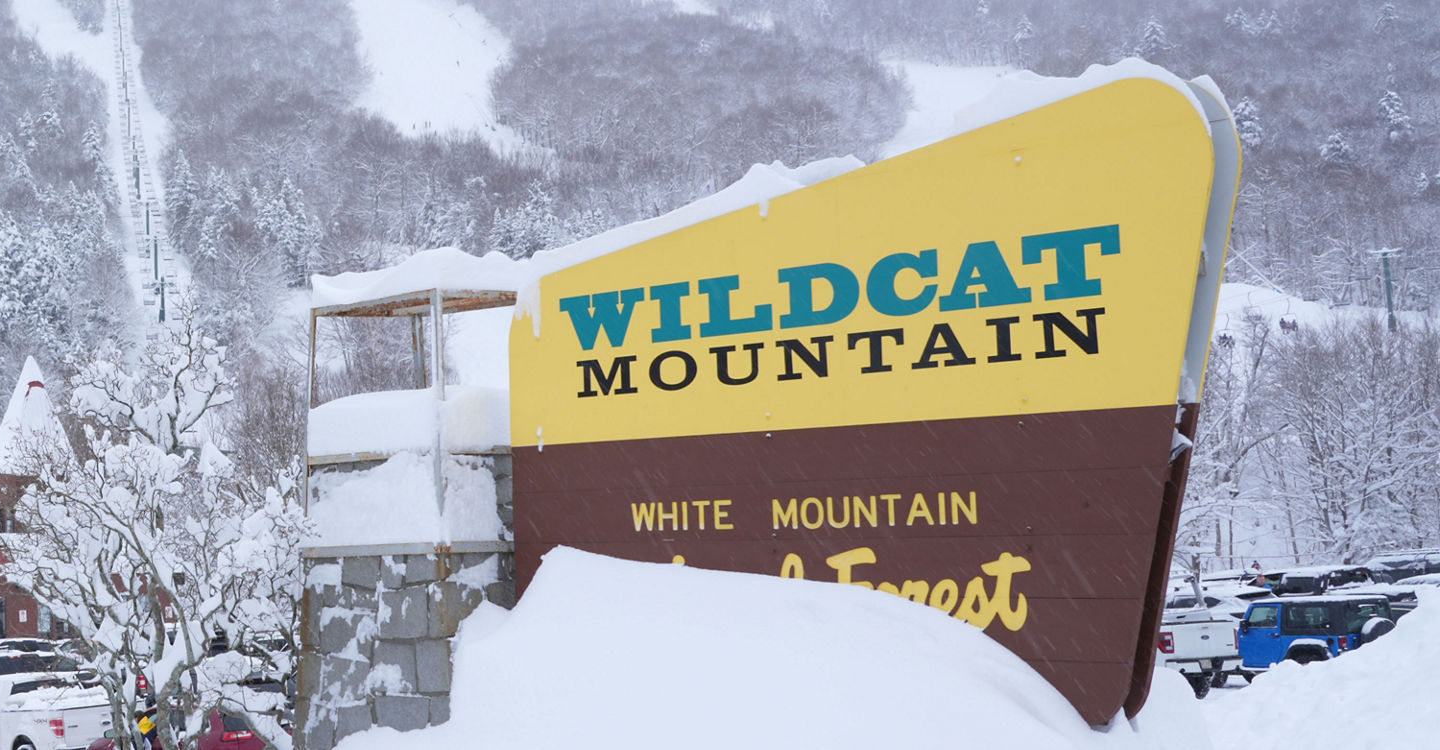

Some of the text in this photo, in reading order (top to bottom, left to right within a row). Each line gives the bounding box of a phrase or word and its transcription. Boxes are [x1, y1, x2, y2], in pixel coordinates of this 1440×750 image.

[559, 224, 1121, 351] WILDCAT
[576, 307, 1106, 398] MOUNTAIN
[631, 491, 978, 531] WHITE MOUNTAIN
[825, 547, 1032, 632] Frest
